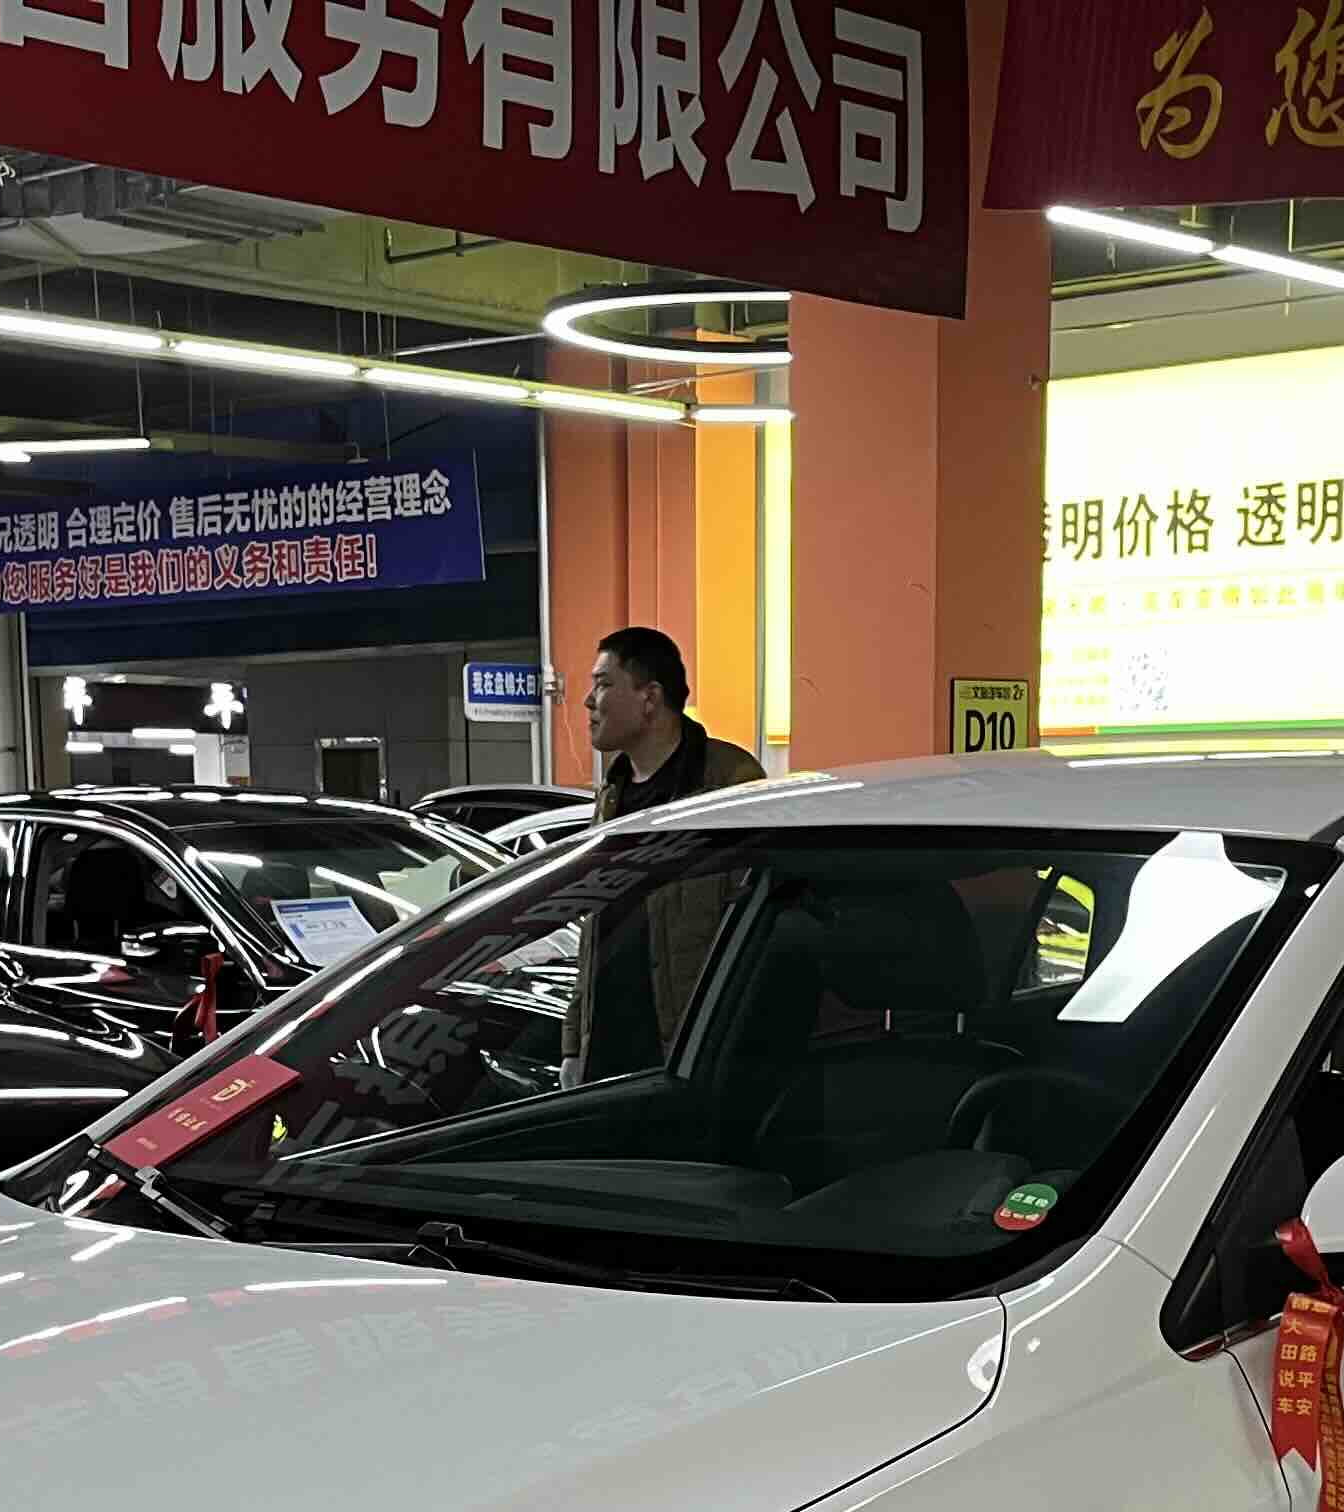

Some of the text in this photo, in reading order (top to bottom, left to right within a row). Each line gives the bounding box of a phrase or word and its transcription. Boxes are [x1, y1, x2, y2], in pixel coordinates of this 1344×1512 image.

[65, 499, 161, 548] 合理定价
[169, 469, 452, 539] 售后无忧的的经营理念
[965, 709, 1016, 753] D10
